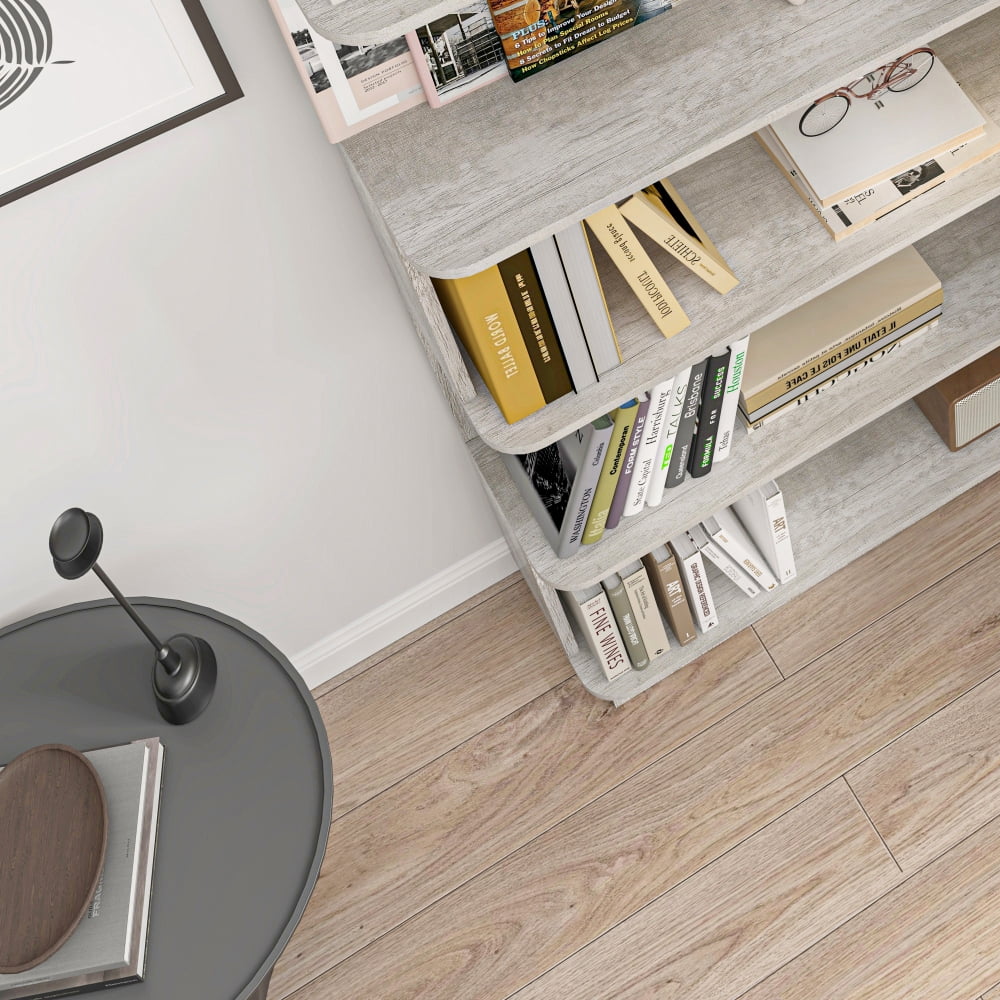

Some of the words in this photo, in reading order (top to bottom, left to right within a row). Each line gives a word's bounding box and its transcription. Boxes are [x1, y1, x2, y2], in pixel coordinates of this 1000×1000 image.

[512, 18, 549, 41] PLUS:
[517, 46, 532, 57] How
[543, 34, 558, 46] Plan
[559, 21, 584, 36] Special
[585, 11, 609, 25] Rooms
[521, 62, 537, 73] How
[577, 34, 598, 47] Affect
[599, 27, 612, 38] Log
[612, 16, 634, 30] Prices
[522, 35, 537, 46] Tips
[547, 18, 575, 34] Improve
[577, 9, 593, 20] Your
[526, 46, 553, 62] Secrets
[563, 36, 573, 45] Fit
[574, 25, 597, 39] Dream
[606, 8, 631, 24] Budget
[684, 373, 703, 419] Brisbane
[713, 366, 726, 399] SUCCESS
[727, 352, 745, 394] Houston
[645, 389, 671, 445] Harrisburg
[666, 384, 688, 439] TALKS
[710, 409, 718, 425] FOR
[625, 448, 636, 475] FORM
[633, 416, 645, 448] STYLE
[661, 444, 673, 470] TED
[701, 435, 715, 468] FORMULA
[570, 487, 592, 544] WASHINGTON
[589, 607, 611, 636] FINE
[600, 632, 624, 670] WINES
